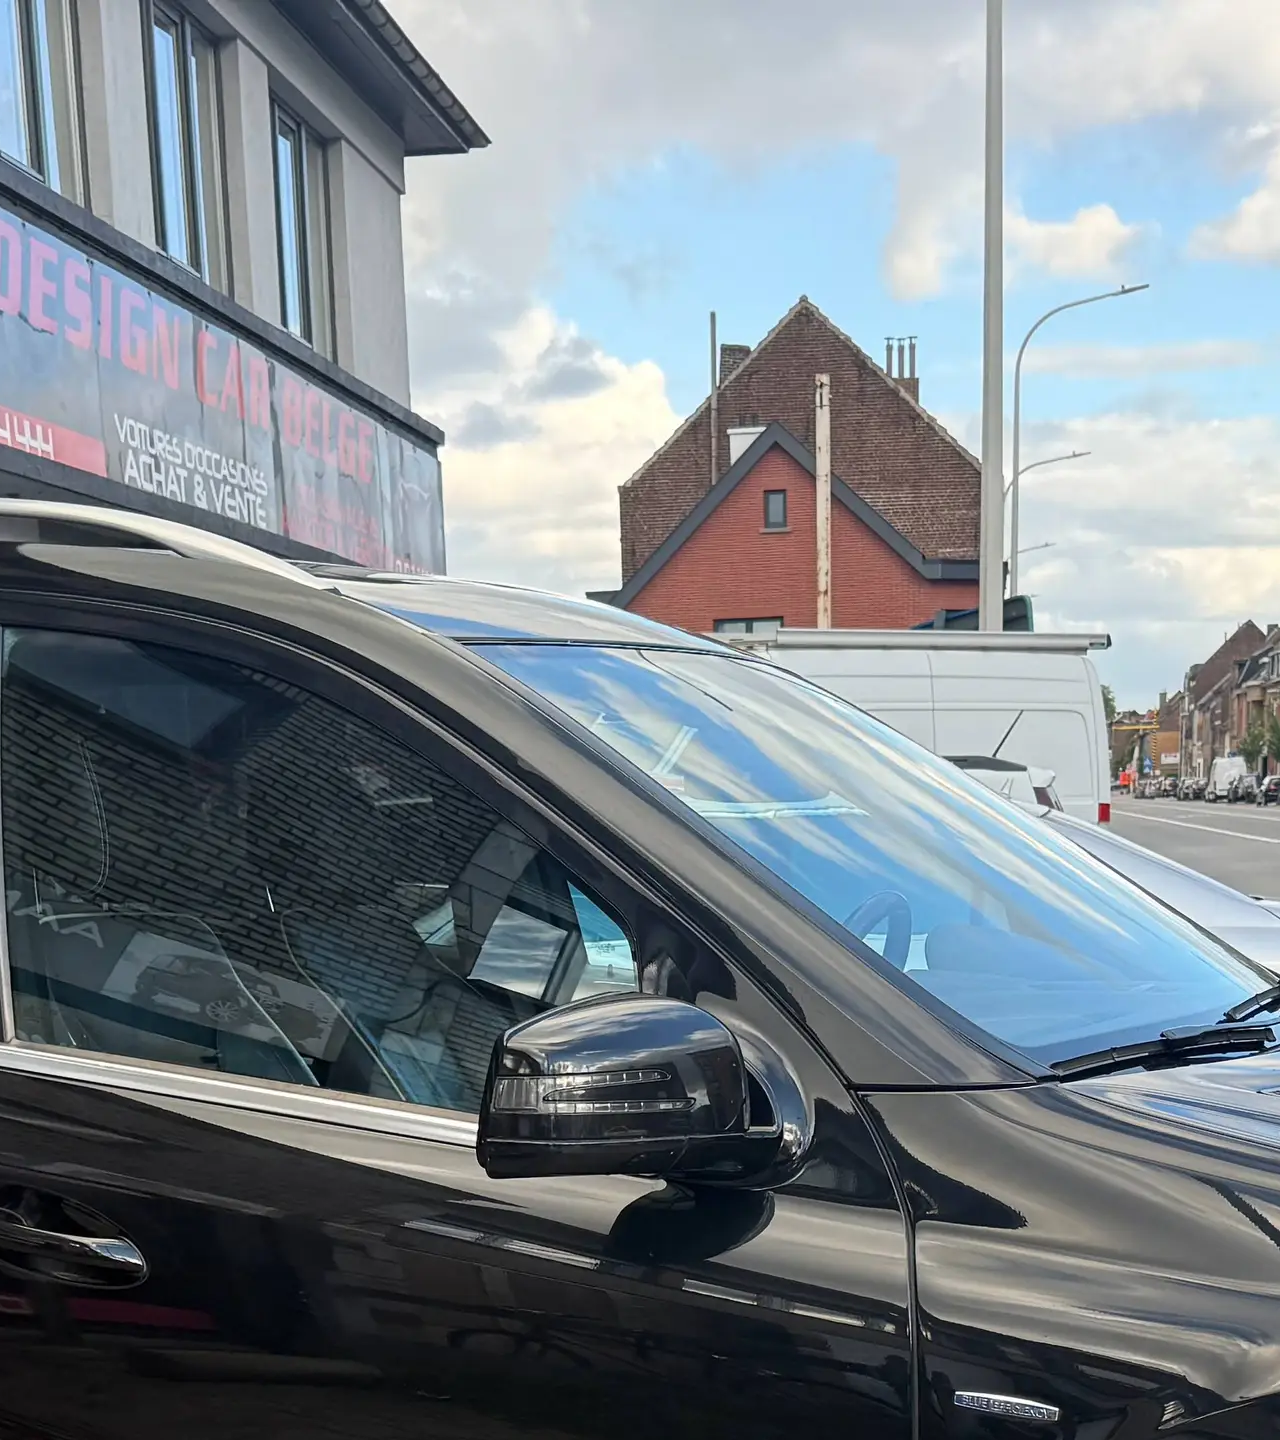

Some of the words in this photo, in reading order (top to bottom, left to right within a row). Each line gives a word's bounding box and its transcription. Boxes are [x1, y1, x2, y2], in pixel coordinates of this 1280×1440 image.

[13, 415, 55, 461] 444
[114, 413, 183, 465] VOITURES
[196, 330, 271, 431] CAR
[281, 375, 375, 484] BELGE
[124, 449, 188, 503] ACHAT
[193, 474, 209, 509] &
[210, 478, 267, 528] VENTE
